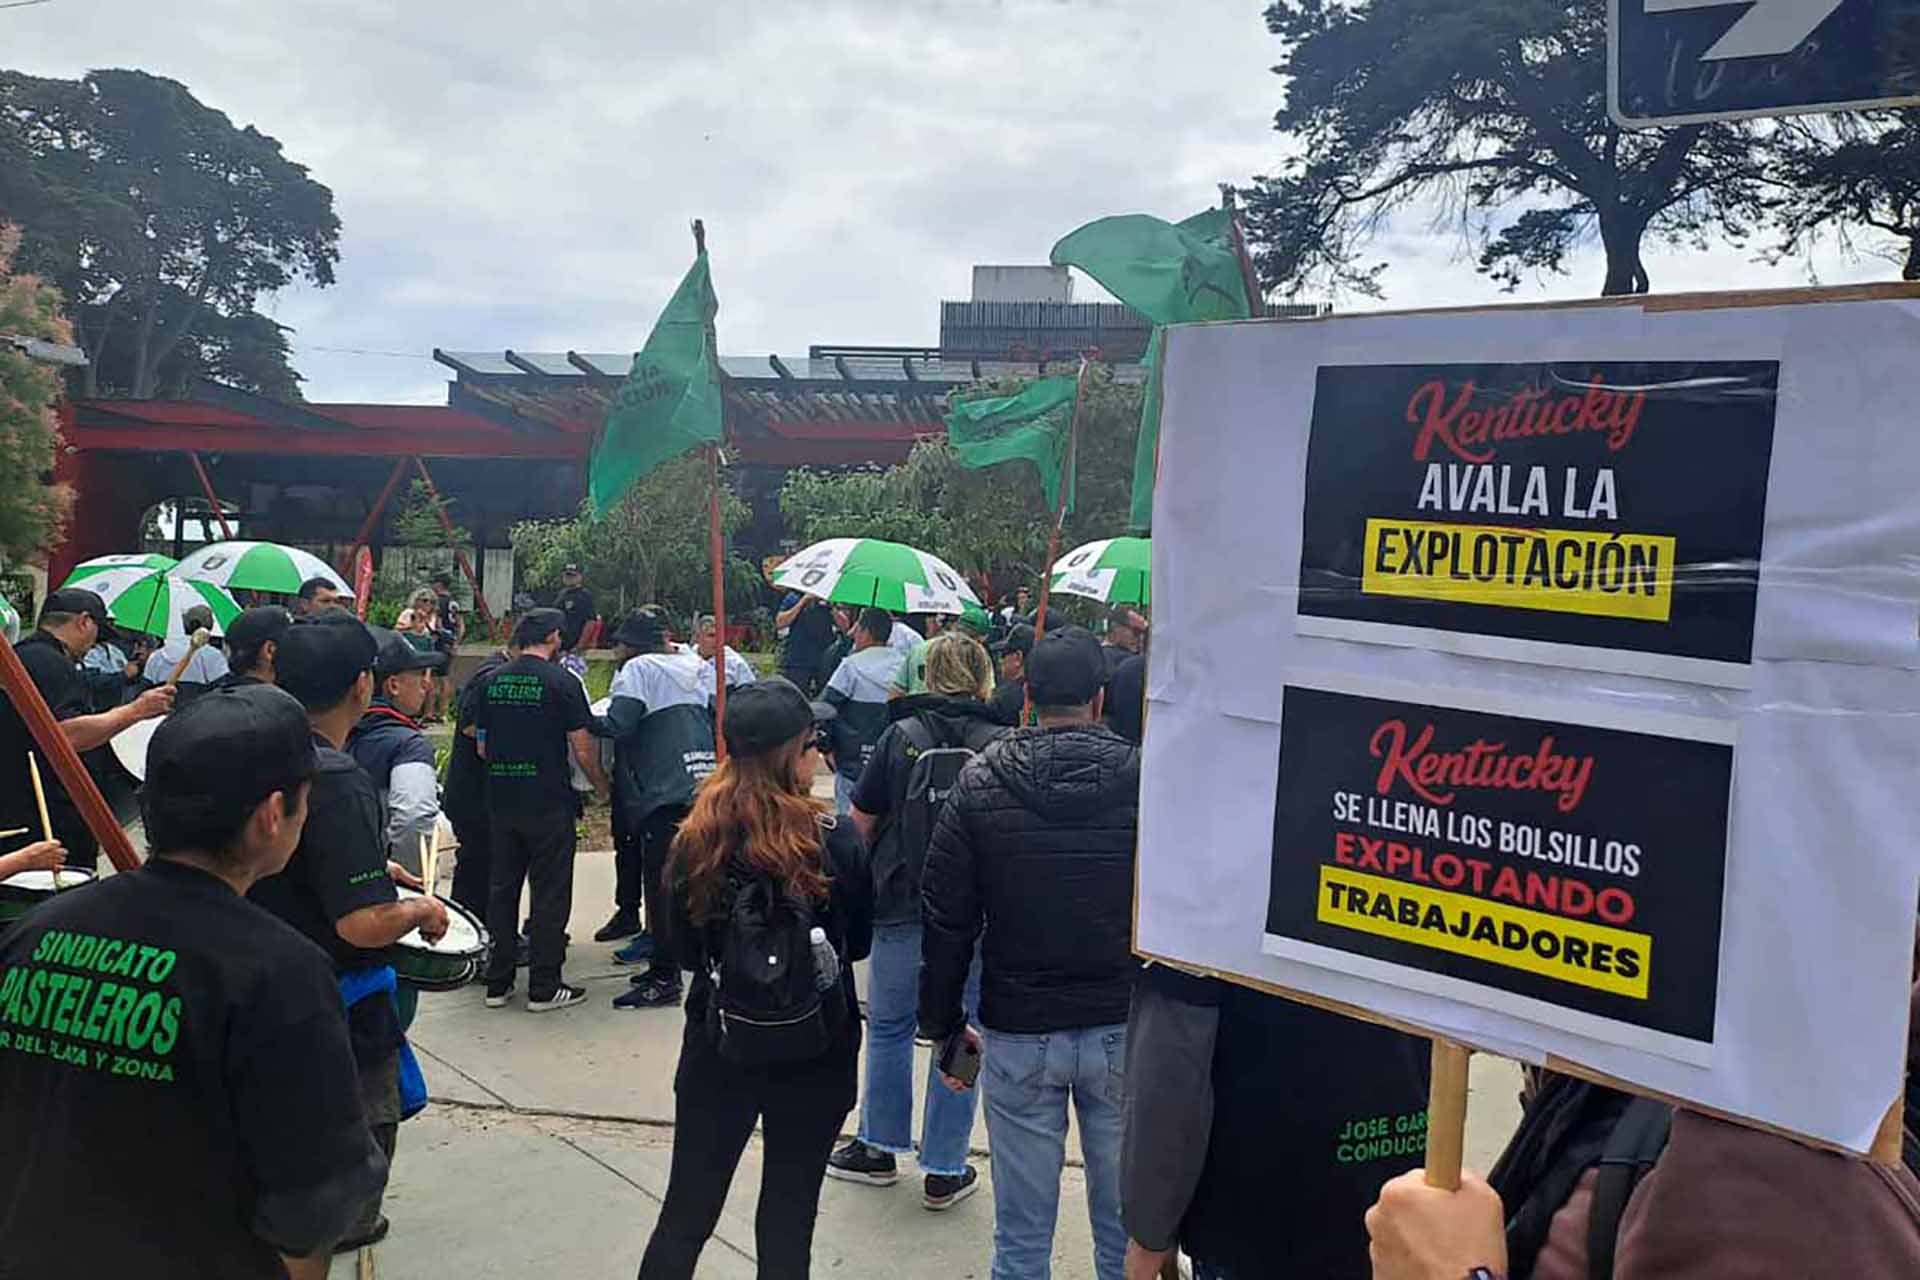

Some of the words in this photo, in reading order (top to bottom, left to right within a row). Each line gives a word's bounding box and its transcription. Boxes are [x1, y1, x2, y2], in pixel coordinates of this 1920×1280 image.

[1407, 373, 1643, 463] Kentucky
[1417, 463, 1548, 516] AVALA
[1563, 467, 1618, 520] LA
[1375, 526, 1660, 597] EXPLOTACIÓN
[1369, 719, 1596, 812] Kentucky
[1333, 791, 1362, 823] SE
[1368, 797, 1440, 839] LLENA
[1447, 811, 1492, 849] LOS
[1500, 821, 1641, 877] BOLSILLOS
[1335, 831, 1635, 924] EXPLOTANDO
[33, 930, 177, 983] SINDICATO
[1325, 880, 1641, 979] TRABAJADORES
[0, 966, 182, 1055] PASTELEROS
[15, 1032, 46, 1054] DEL
[96, 1051, 108, 1070] Y
[111, 1056, 174, 1081] ZONA
[1336, 1134, 1426, 1162] CONDUCC
[1338, 1116, 1389, 1140] JOSE
[1395, 1112, 1426, 1133] GAR
